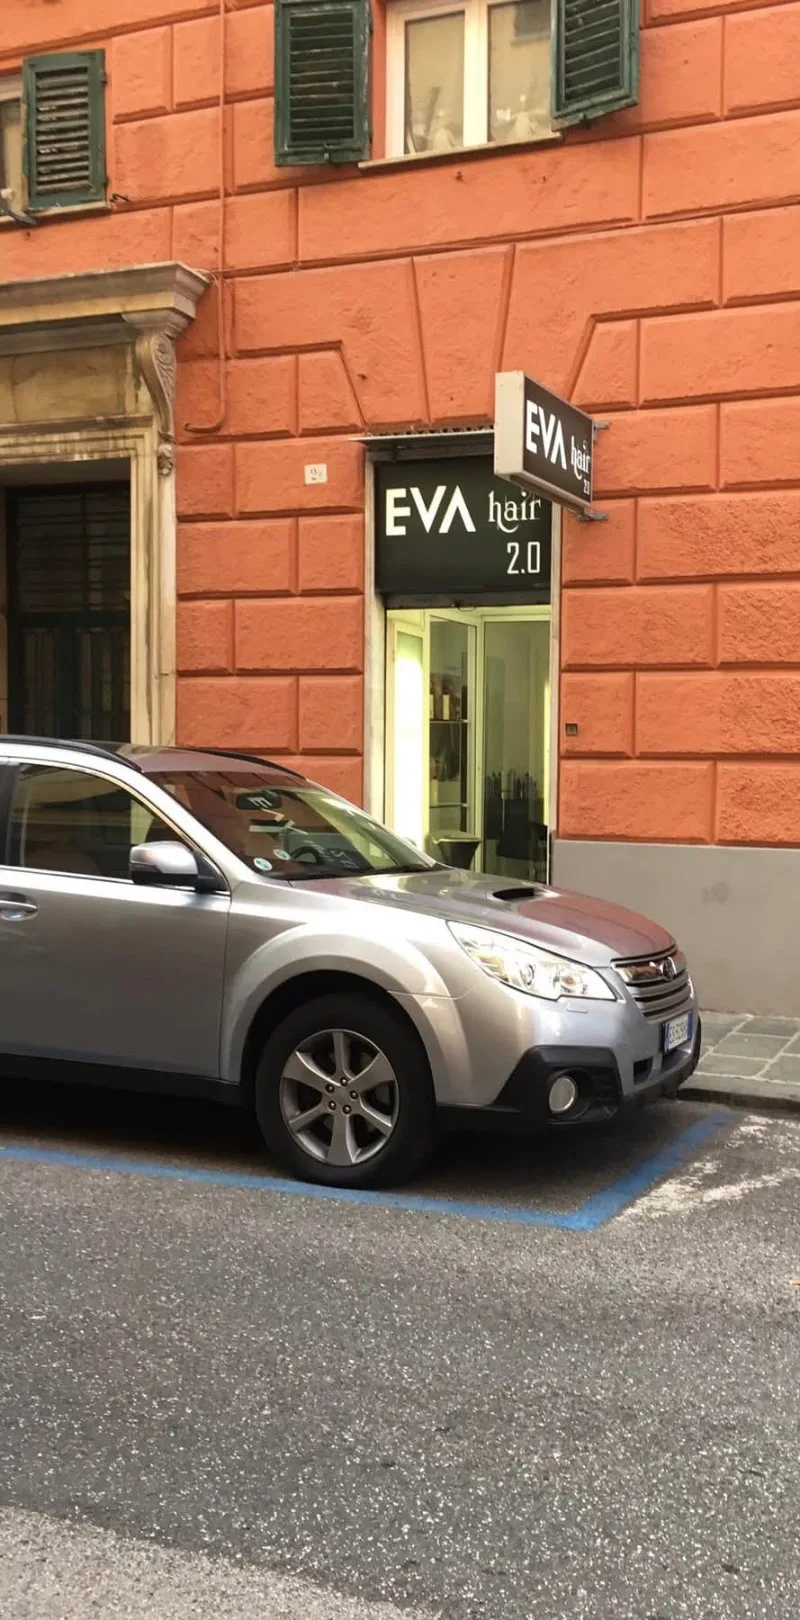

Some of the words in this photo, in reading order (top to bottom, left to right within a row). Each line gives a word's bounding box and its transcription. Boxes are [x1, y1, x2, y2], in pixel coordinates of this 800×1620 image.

[526, 399, 567, 470] EVA
[570, 435, 590, 480] hair
[386, 485, 476, 536] EVA
[488, 491, 541, 533] hair
[507, 541, 540, 574] 2.0
